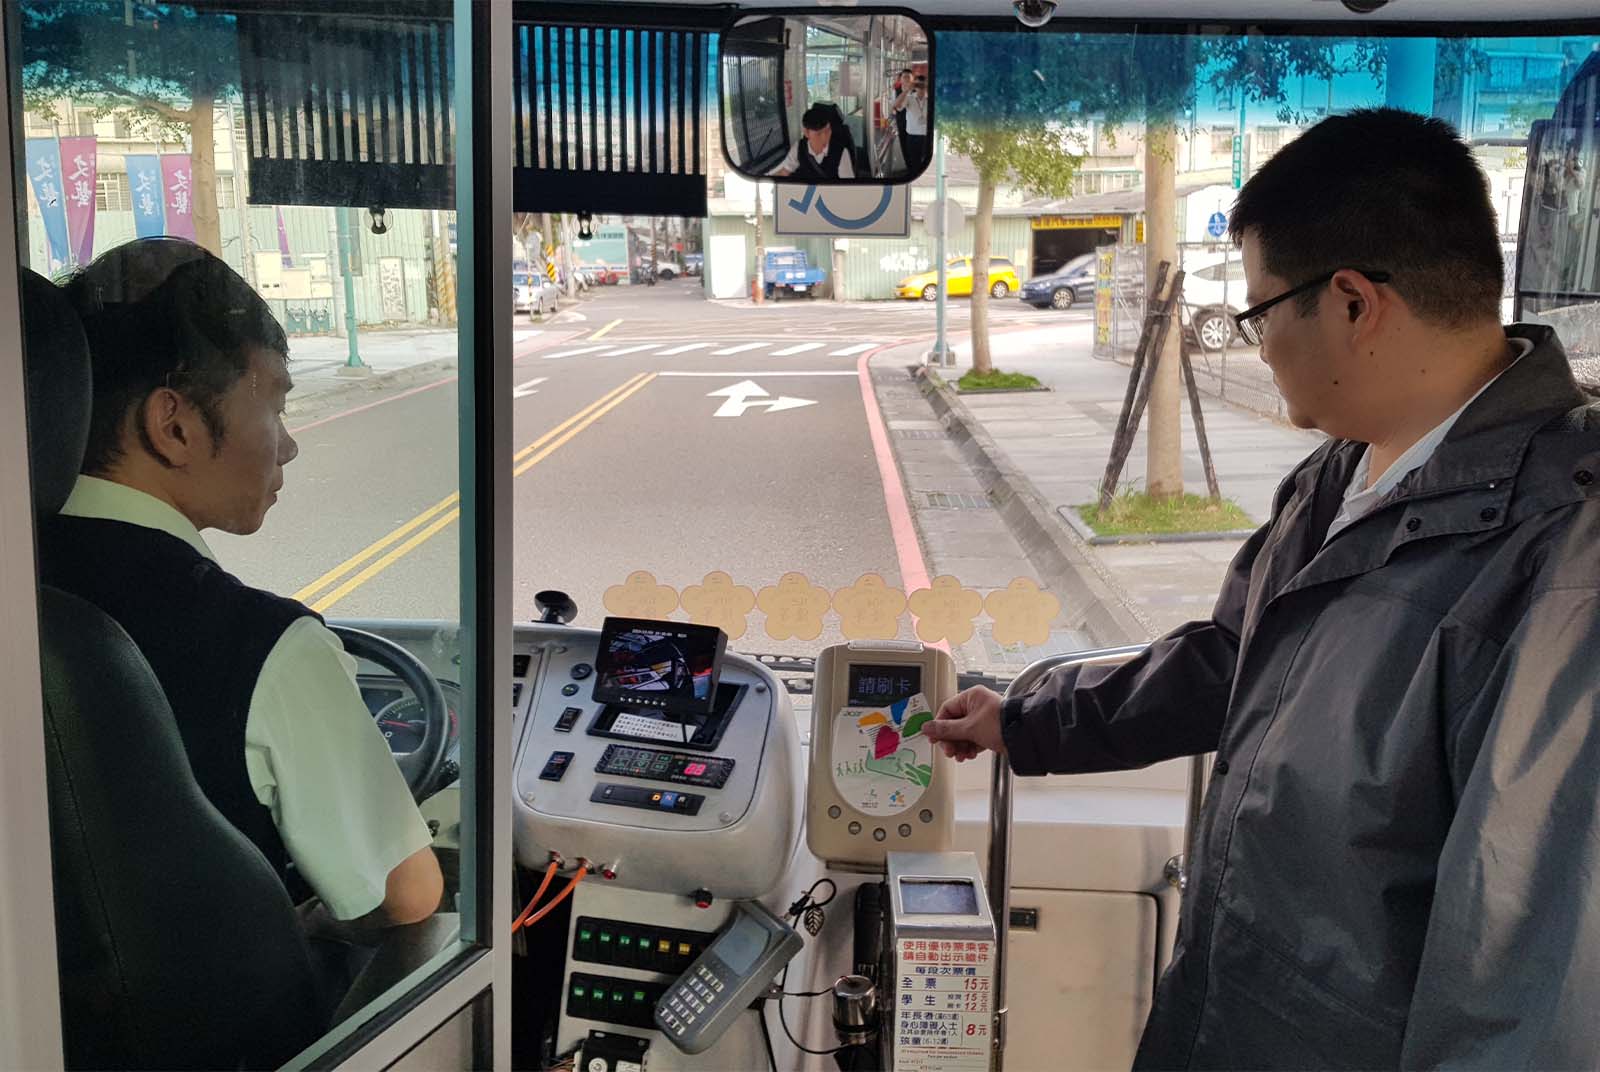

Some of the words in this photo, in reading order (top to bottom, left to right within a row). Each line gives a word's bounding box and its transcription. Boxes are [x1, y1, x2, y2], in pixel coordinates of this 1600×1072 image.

[858, 677, 911, 695] 請刷卡
[903, 941, 989, 953] 使用優待票乘客
[903, 951, 989, 962] 請自動出示證件
[915, 967, 976, 976] 每段次票價
